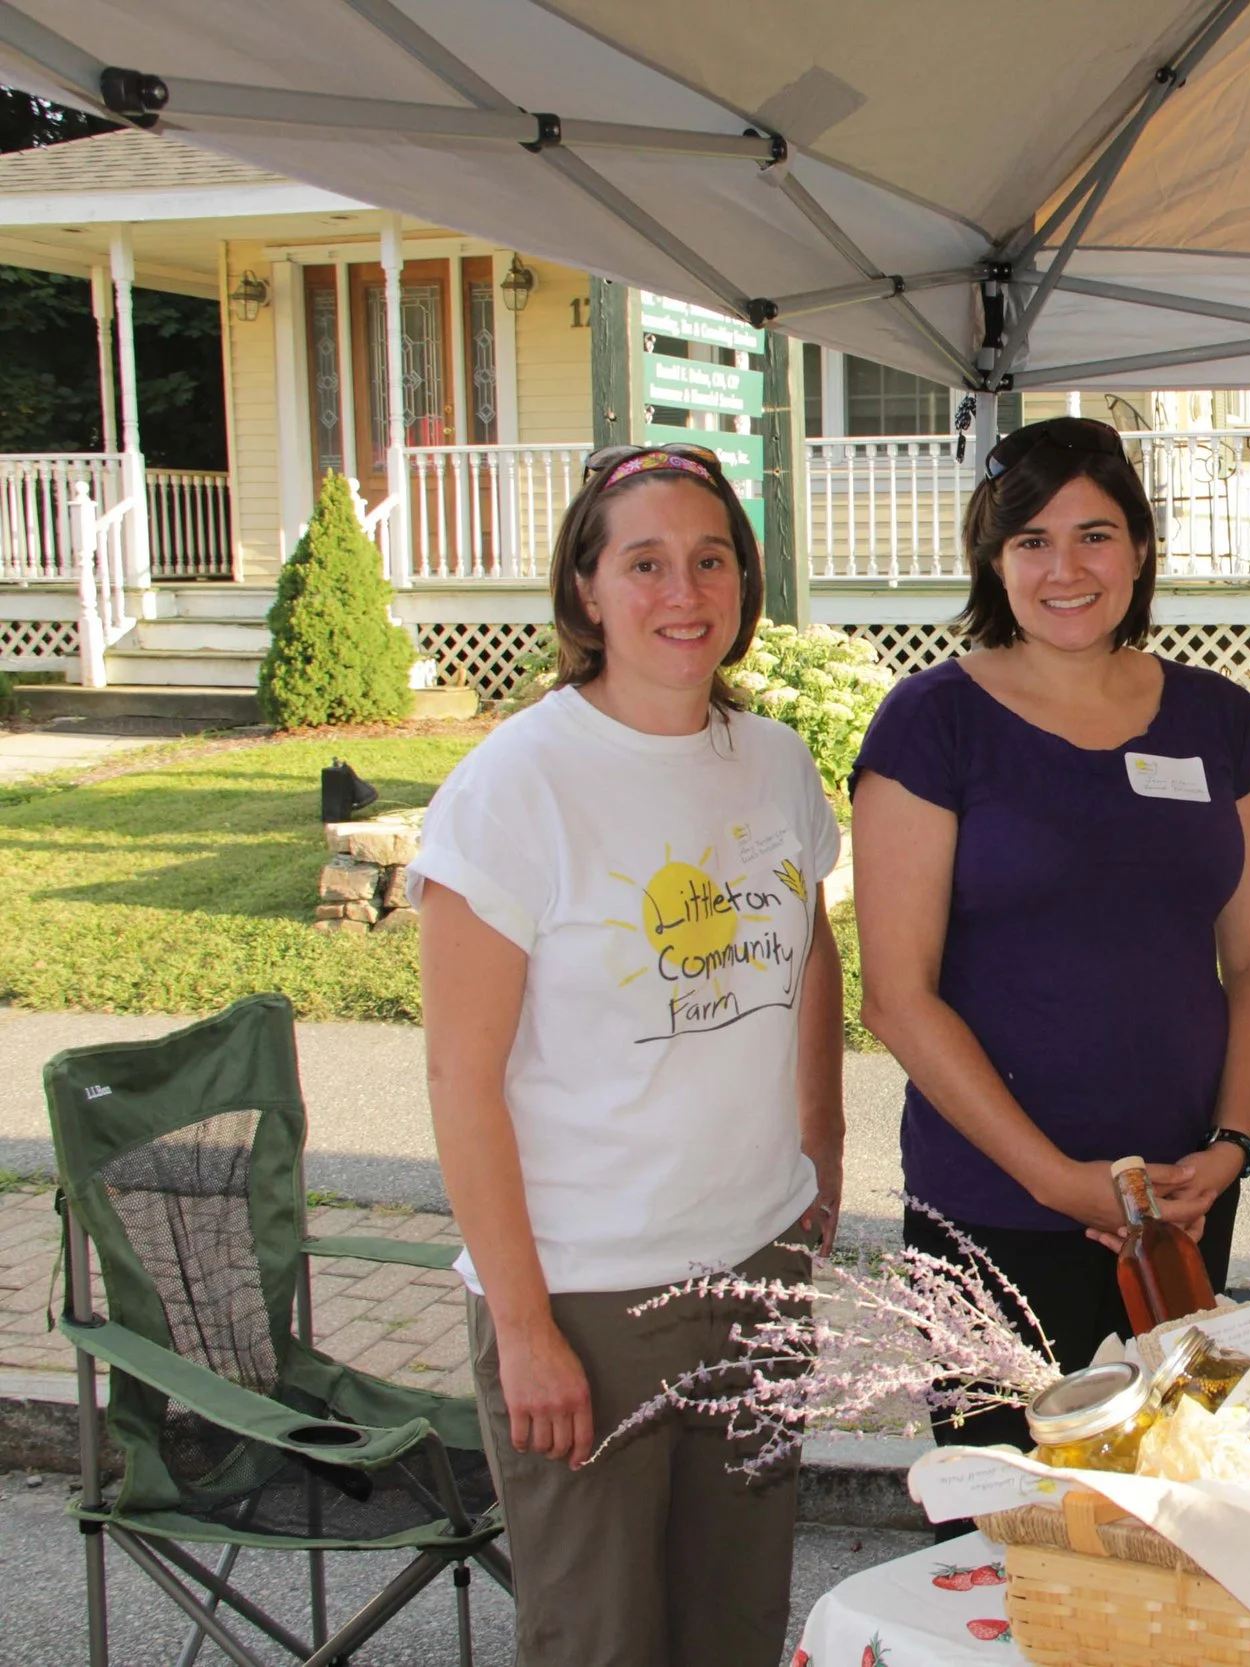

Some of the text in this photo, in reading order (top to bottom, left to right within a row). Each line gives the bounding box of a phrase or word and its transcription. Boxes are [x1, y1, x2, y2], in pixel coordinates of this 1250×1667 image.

[642, 880, 781, 935] Littleton
[658, 932, 793, 994] Community
[669, 989, 741, 1033] Farm
